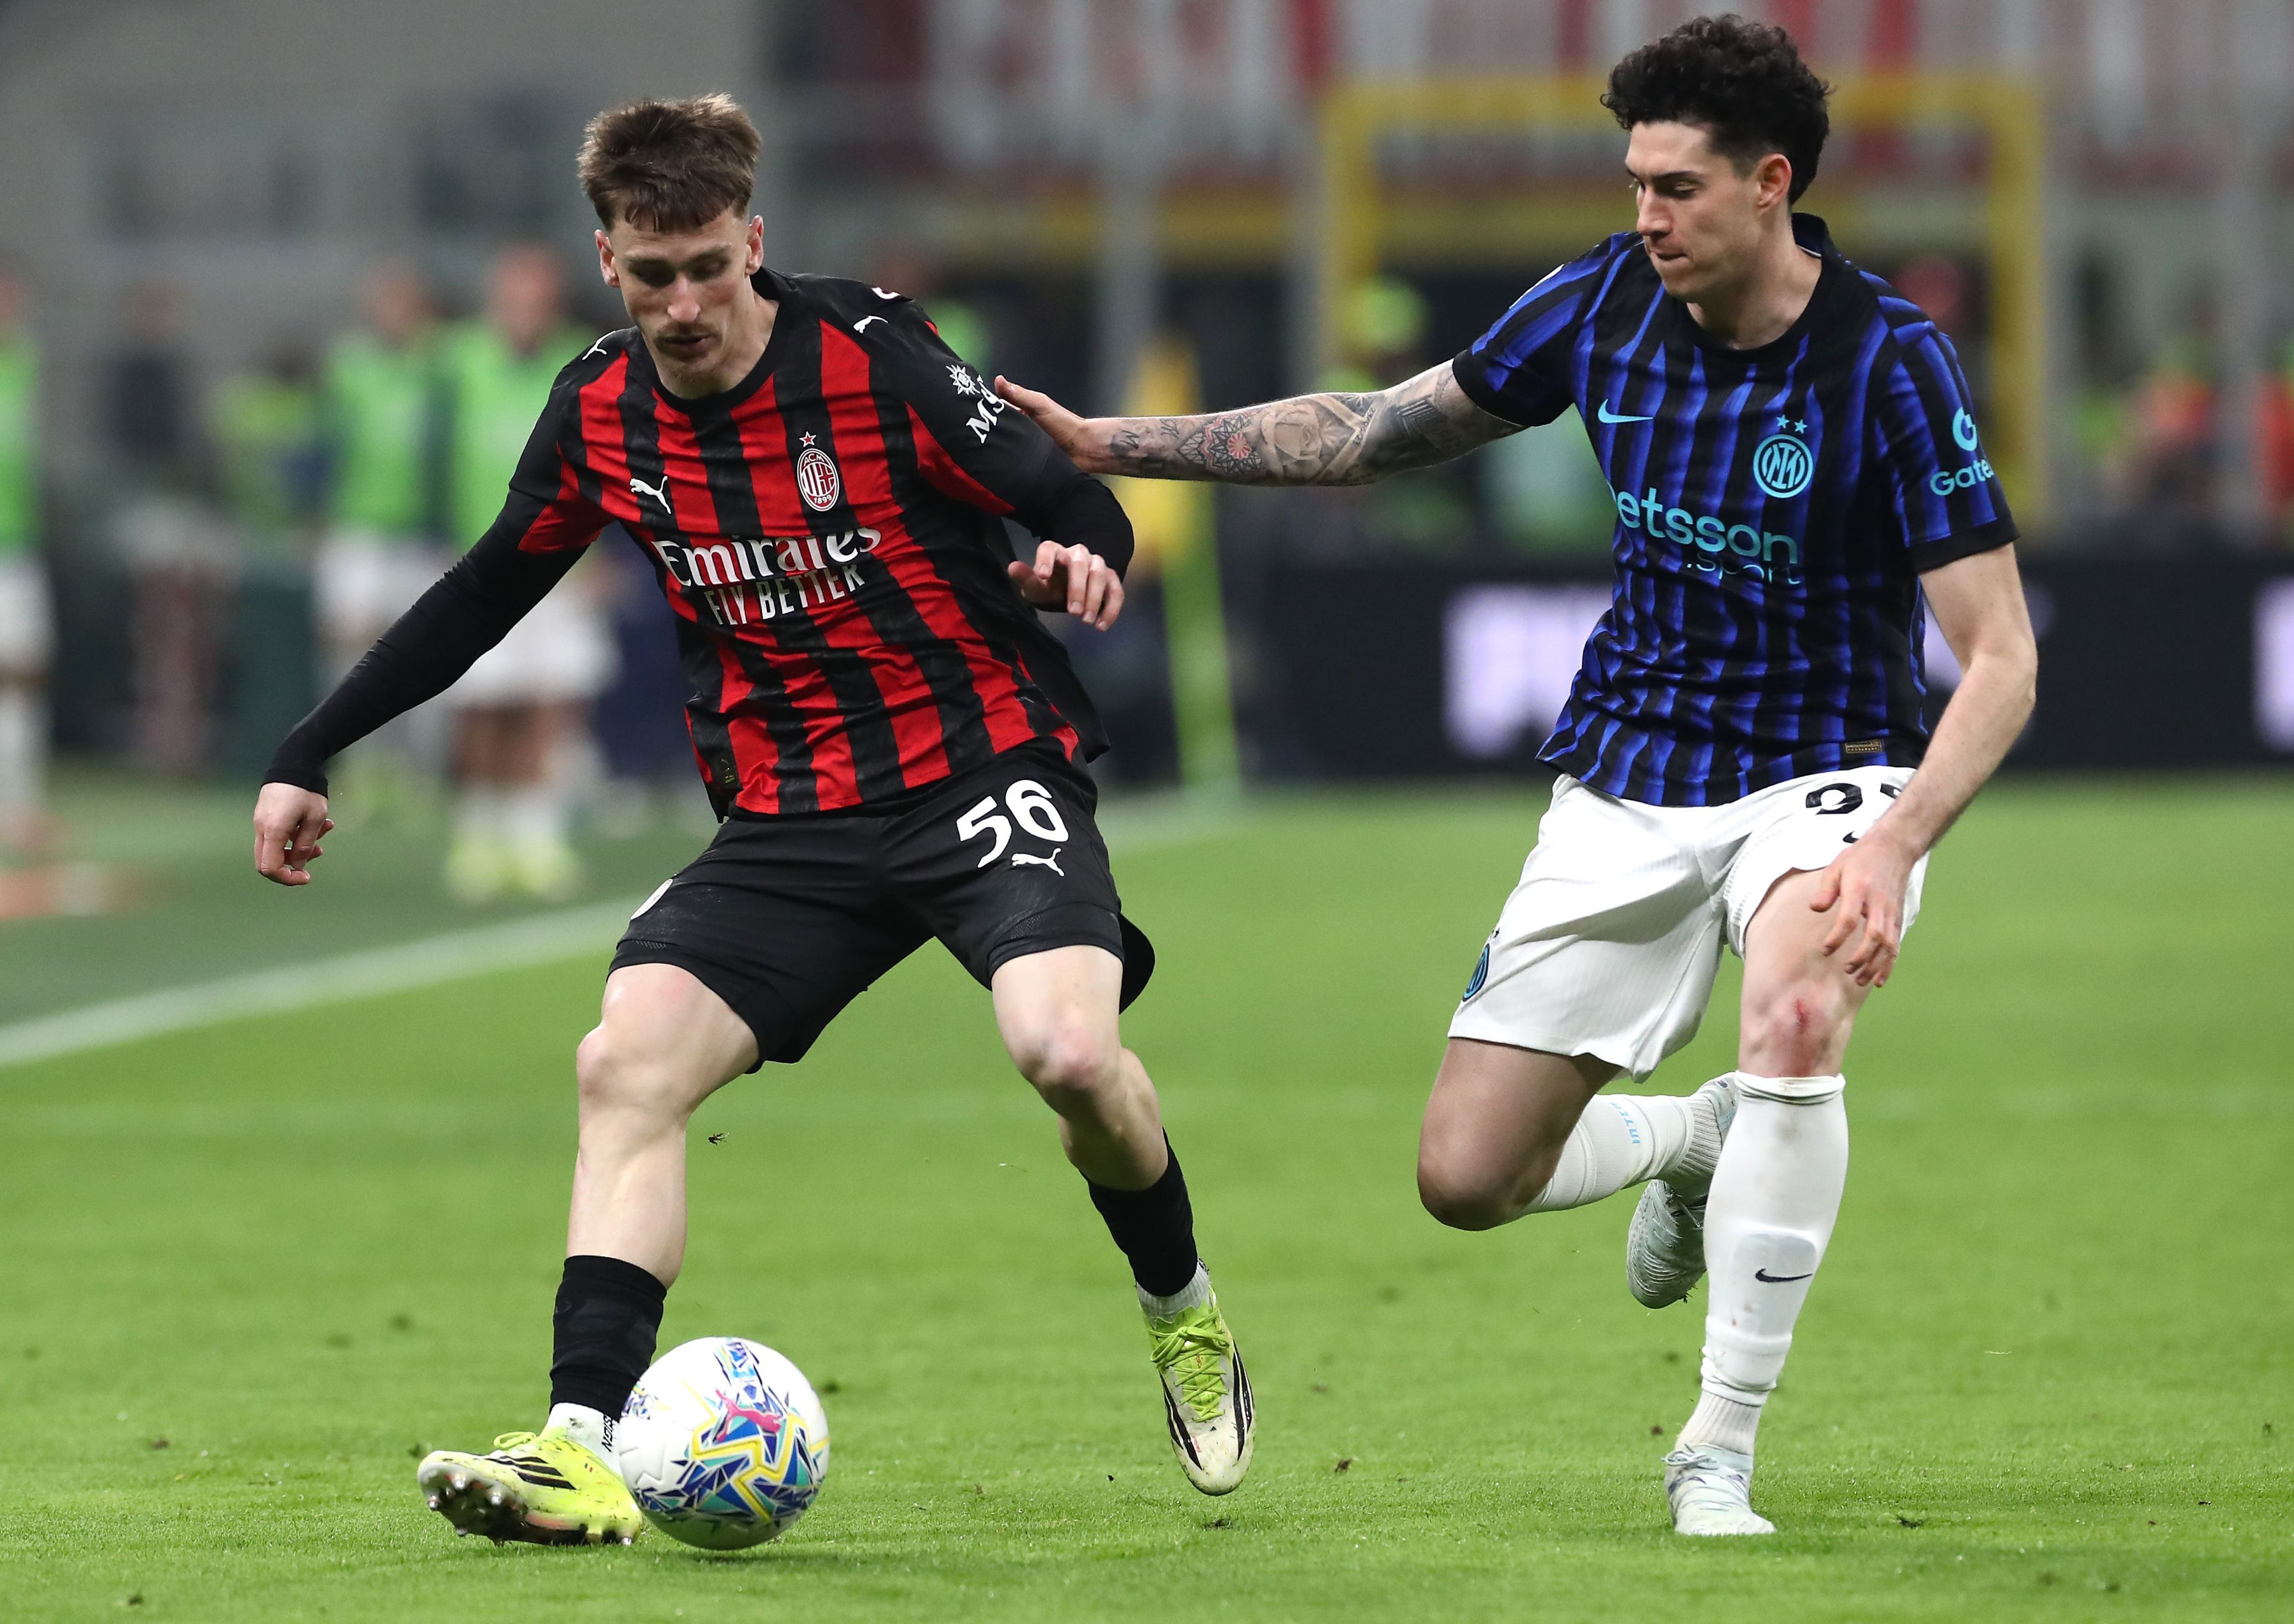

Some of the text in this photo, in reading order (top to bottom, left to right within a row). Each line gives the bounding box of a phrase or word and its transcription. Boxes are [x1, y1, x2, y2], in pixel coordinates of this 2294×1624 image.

[966, 375, 1005, 444] MS
[804, 453, 825, 467] ACM
[814, 495, 832, 504] 1899
[1606, 479, 1798, 564] etsson
[651, 527, 882, 587] Emirates
[704, 564, 865, 625] FLY BETTER
[956, 779, 1069, 869] 56
